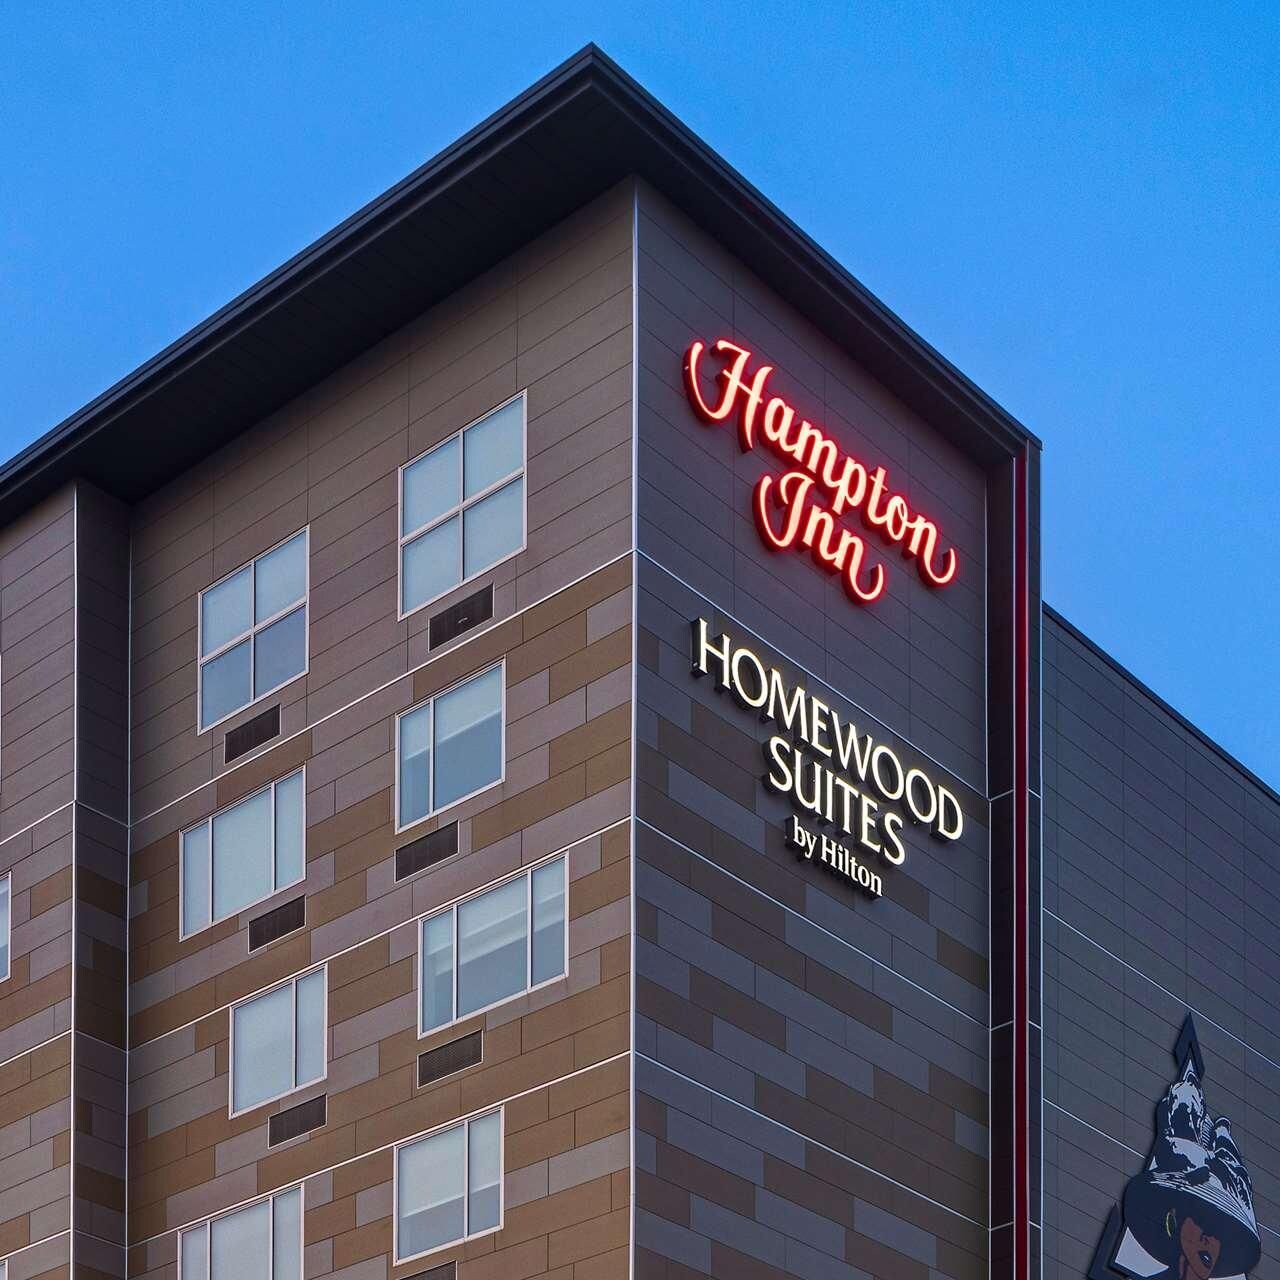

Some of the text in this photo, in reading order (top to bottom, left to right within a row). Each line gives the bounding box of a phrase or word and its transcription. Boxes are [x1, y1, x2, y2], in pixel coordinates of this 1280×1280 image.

[686, 340, 956, 584] Hampton
[757, 472, 883, 600] Inn
[696, 617, 963, 840] HOMEWOOD
[768, 736, 906, 865] SUITES
[793, 815, 883, 897] by Hilton
